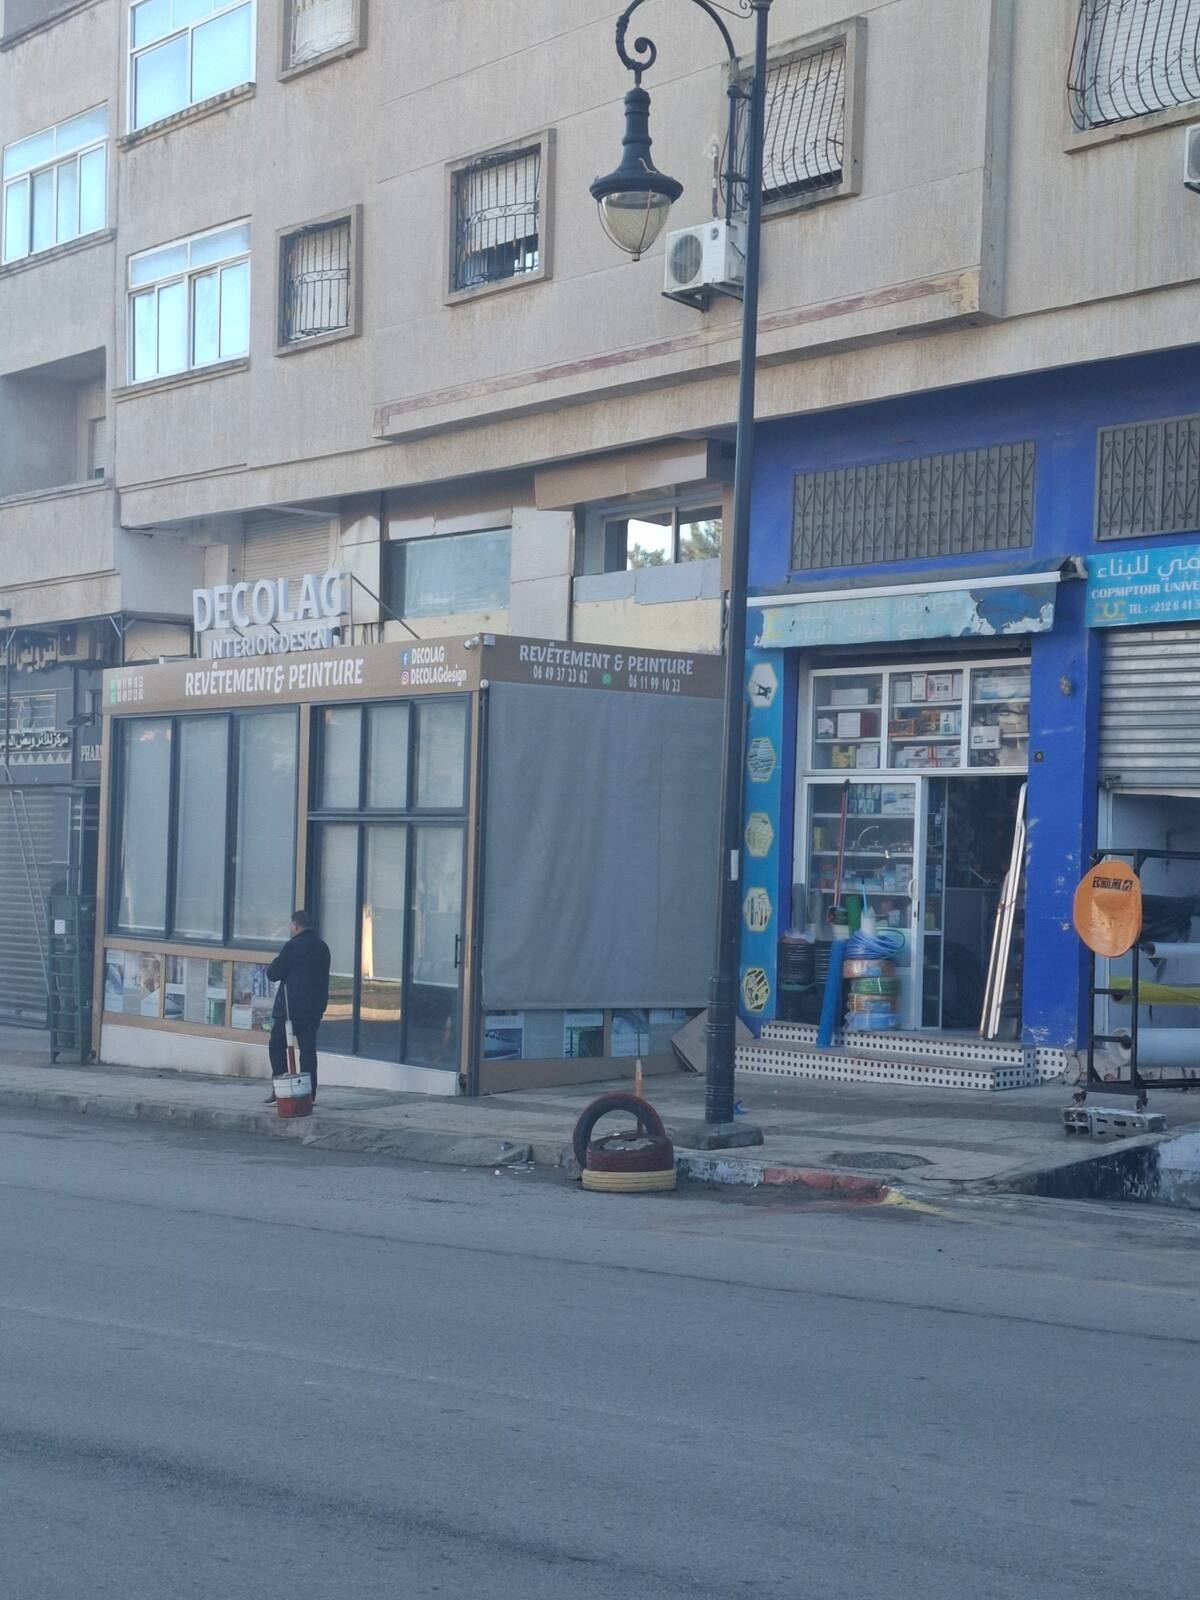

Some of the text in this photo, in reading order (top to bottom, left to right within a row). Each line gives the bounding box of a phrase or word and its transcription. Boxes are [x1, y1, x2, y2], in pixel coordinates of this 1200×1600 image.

[1096, 554, 1149, 580] للبناء
[193, 568, 345, 633] DECOLAG
[279, 627, 330, 653] DESIGN
[411, 645, 445, 665] DECOLAG
[519, 641, 694, 676] REVÊTEMENT & PEINTURE
[289, 658, 363, 691] PEINTURE
[410, 664, 467, 687] DECOLAGdesign
[533, 664, 542, 680] 06
[640, 675, 648, 689] 11
[80, 744, 101, 762] PHAR
